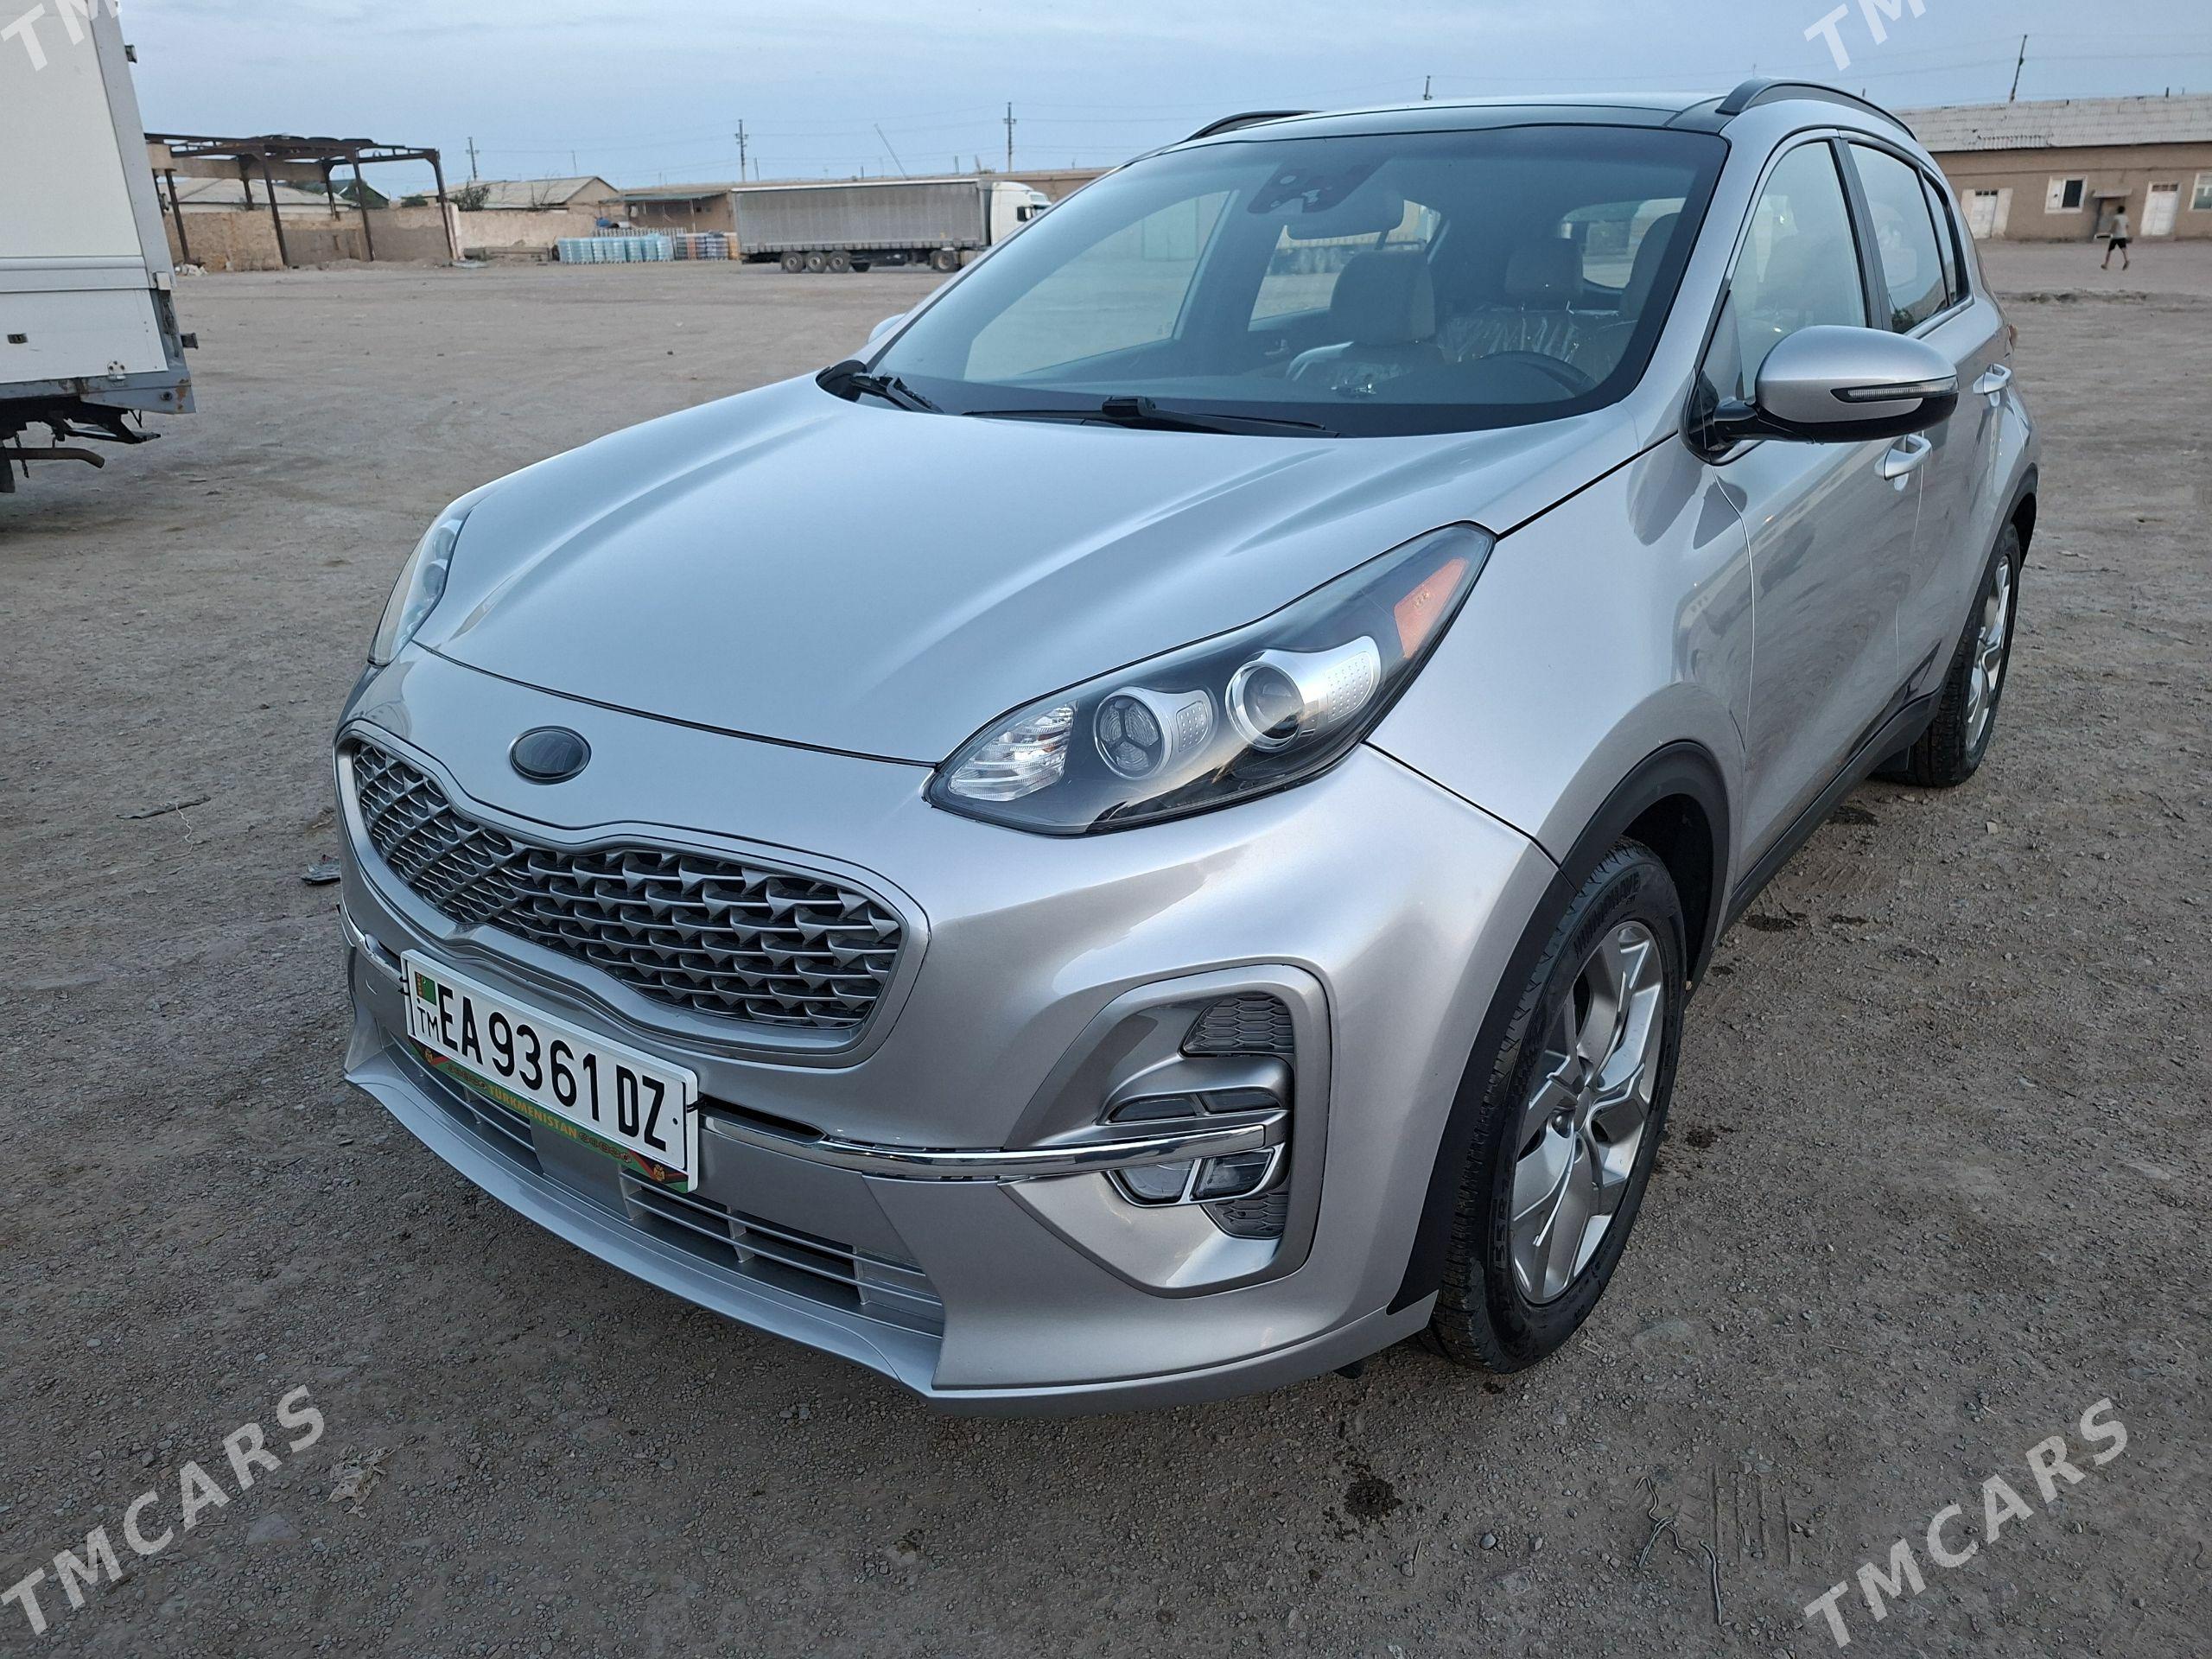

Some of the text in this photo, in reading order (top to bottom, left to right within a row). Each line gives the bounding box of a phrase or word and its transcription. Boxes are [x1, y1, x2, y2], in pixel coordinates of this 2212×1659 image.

[416, 1007, 440, 1042] TM
[437, 983, 667, 1152] EA 9361 DZ
